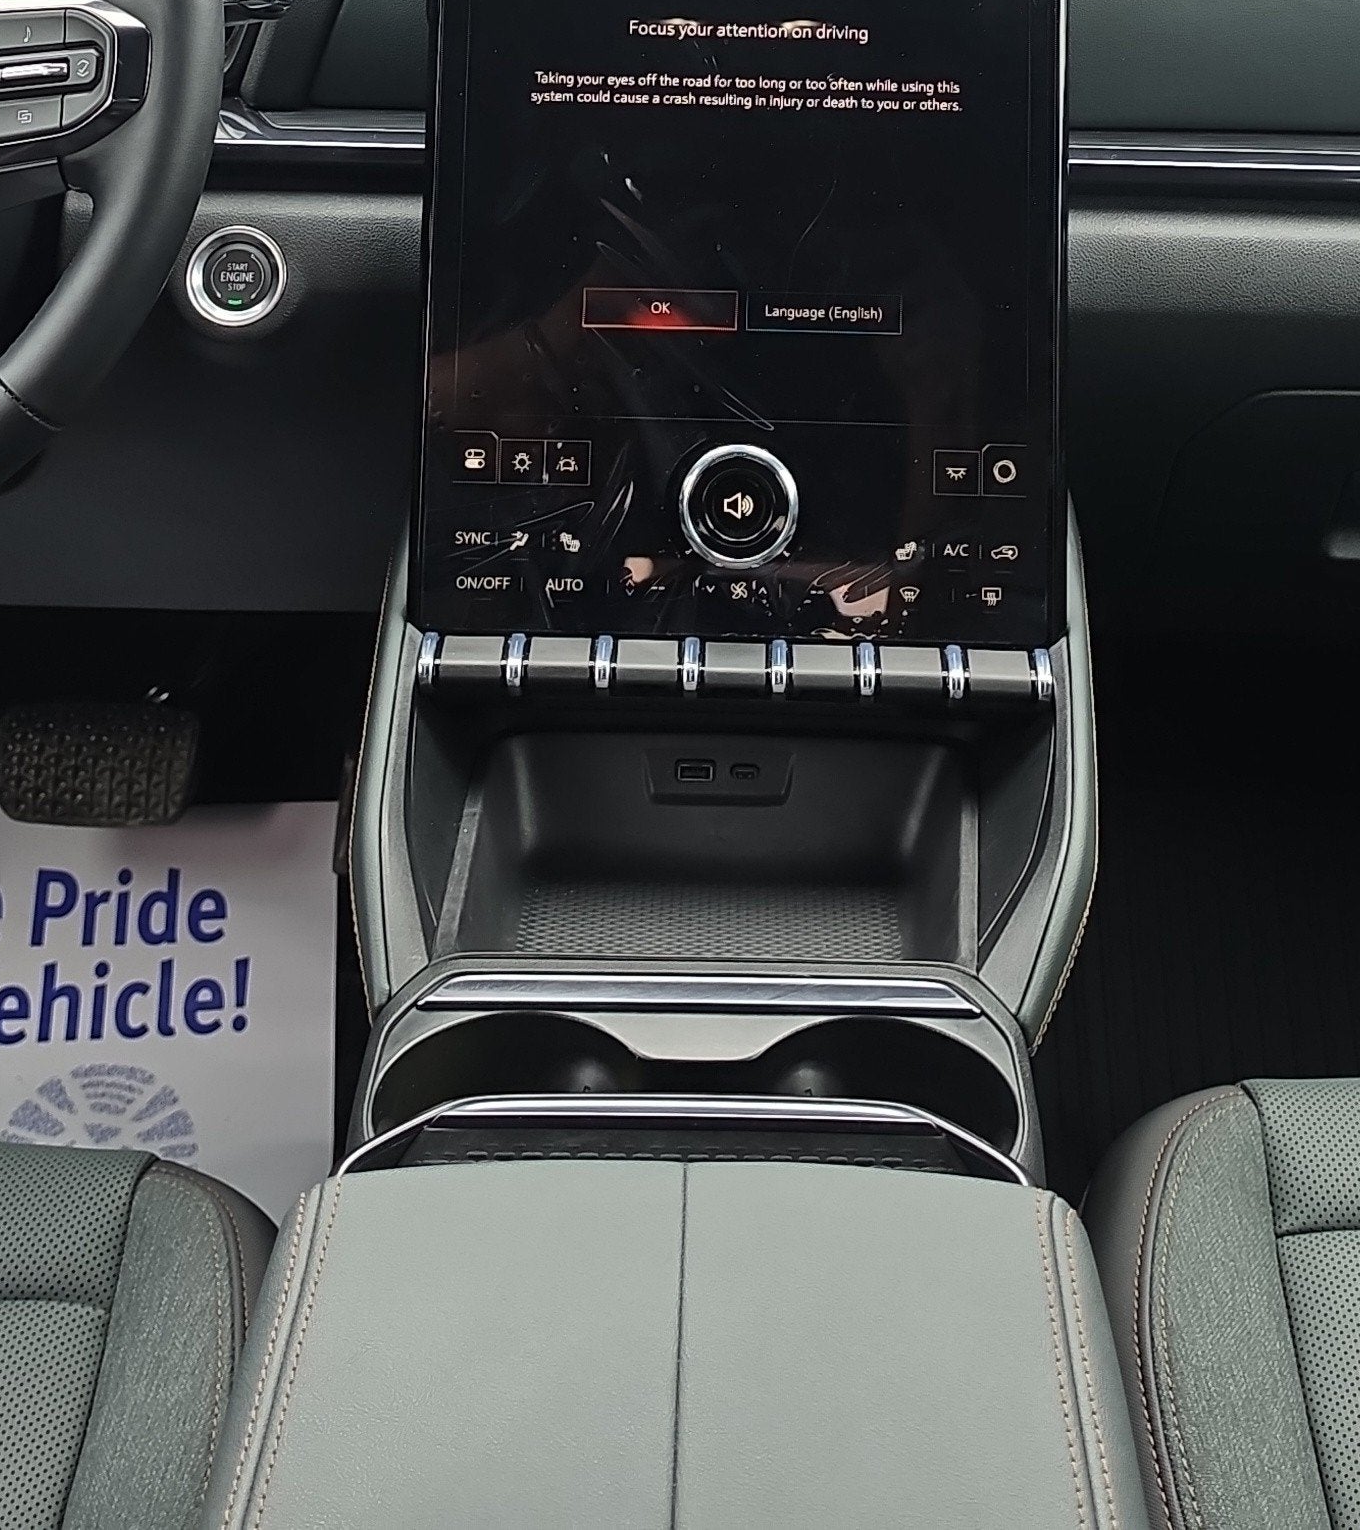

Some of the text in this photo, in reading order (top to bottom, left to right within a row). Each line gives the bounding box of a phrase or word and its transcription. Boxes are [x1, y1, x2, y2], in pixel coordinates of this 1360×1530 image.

[629, 21, 869, 43] Focus your attention on driving
[535, 71, 960, 95] Taking your eyes off the road for too long or too often while using this
[530, 91, 962, 112] system could cause a crash resulting in injury or death to you or others.
[220, 272, 255, 282] ENGINE
[227, 283, 246, 291] STOP
[651, 302, 670, 315] OK
[765, 304, 883, 322] Language (English)
[455, 532, 490, 545] SYNC
[943, 544, 969, 557] A/C
[456, 576, 510, 590] ON/OFF
[546, 578, 583, 591] AUTO
[30, 869, 230, 948] Pride
